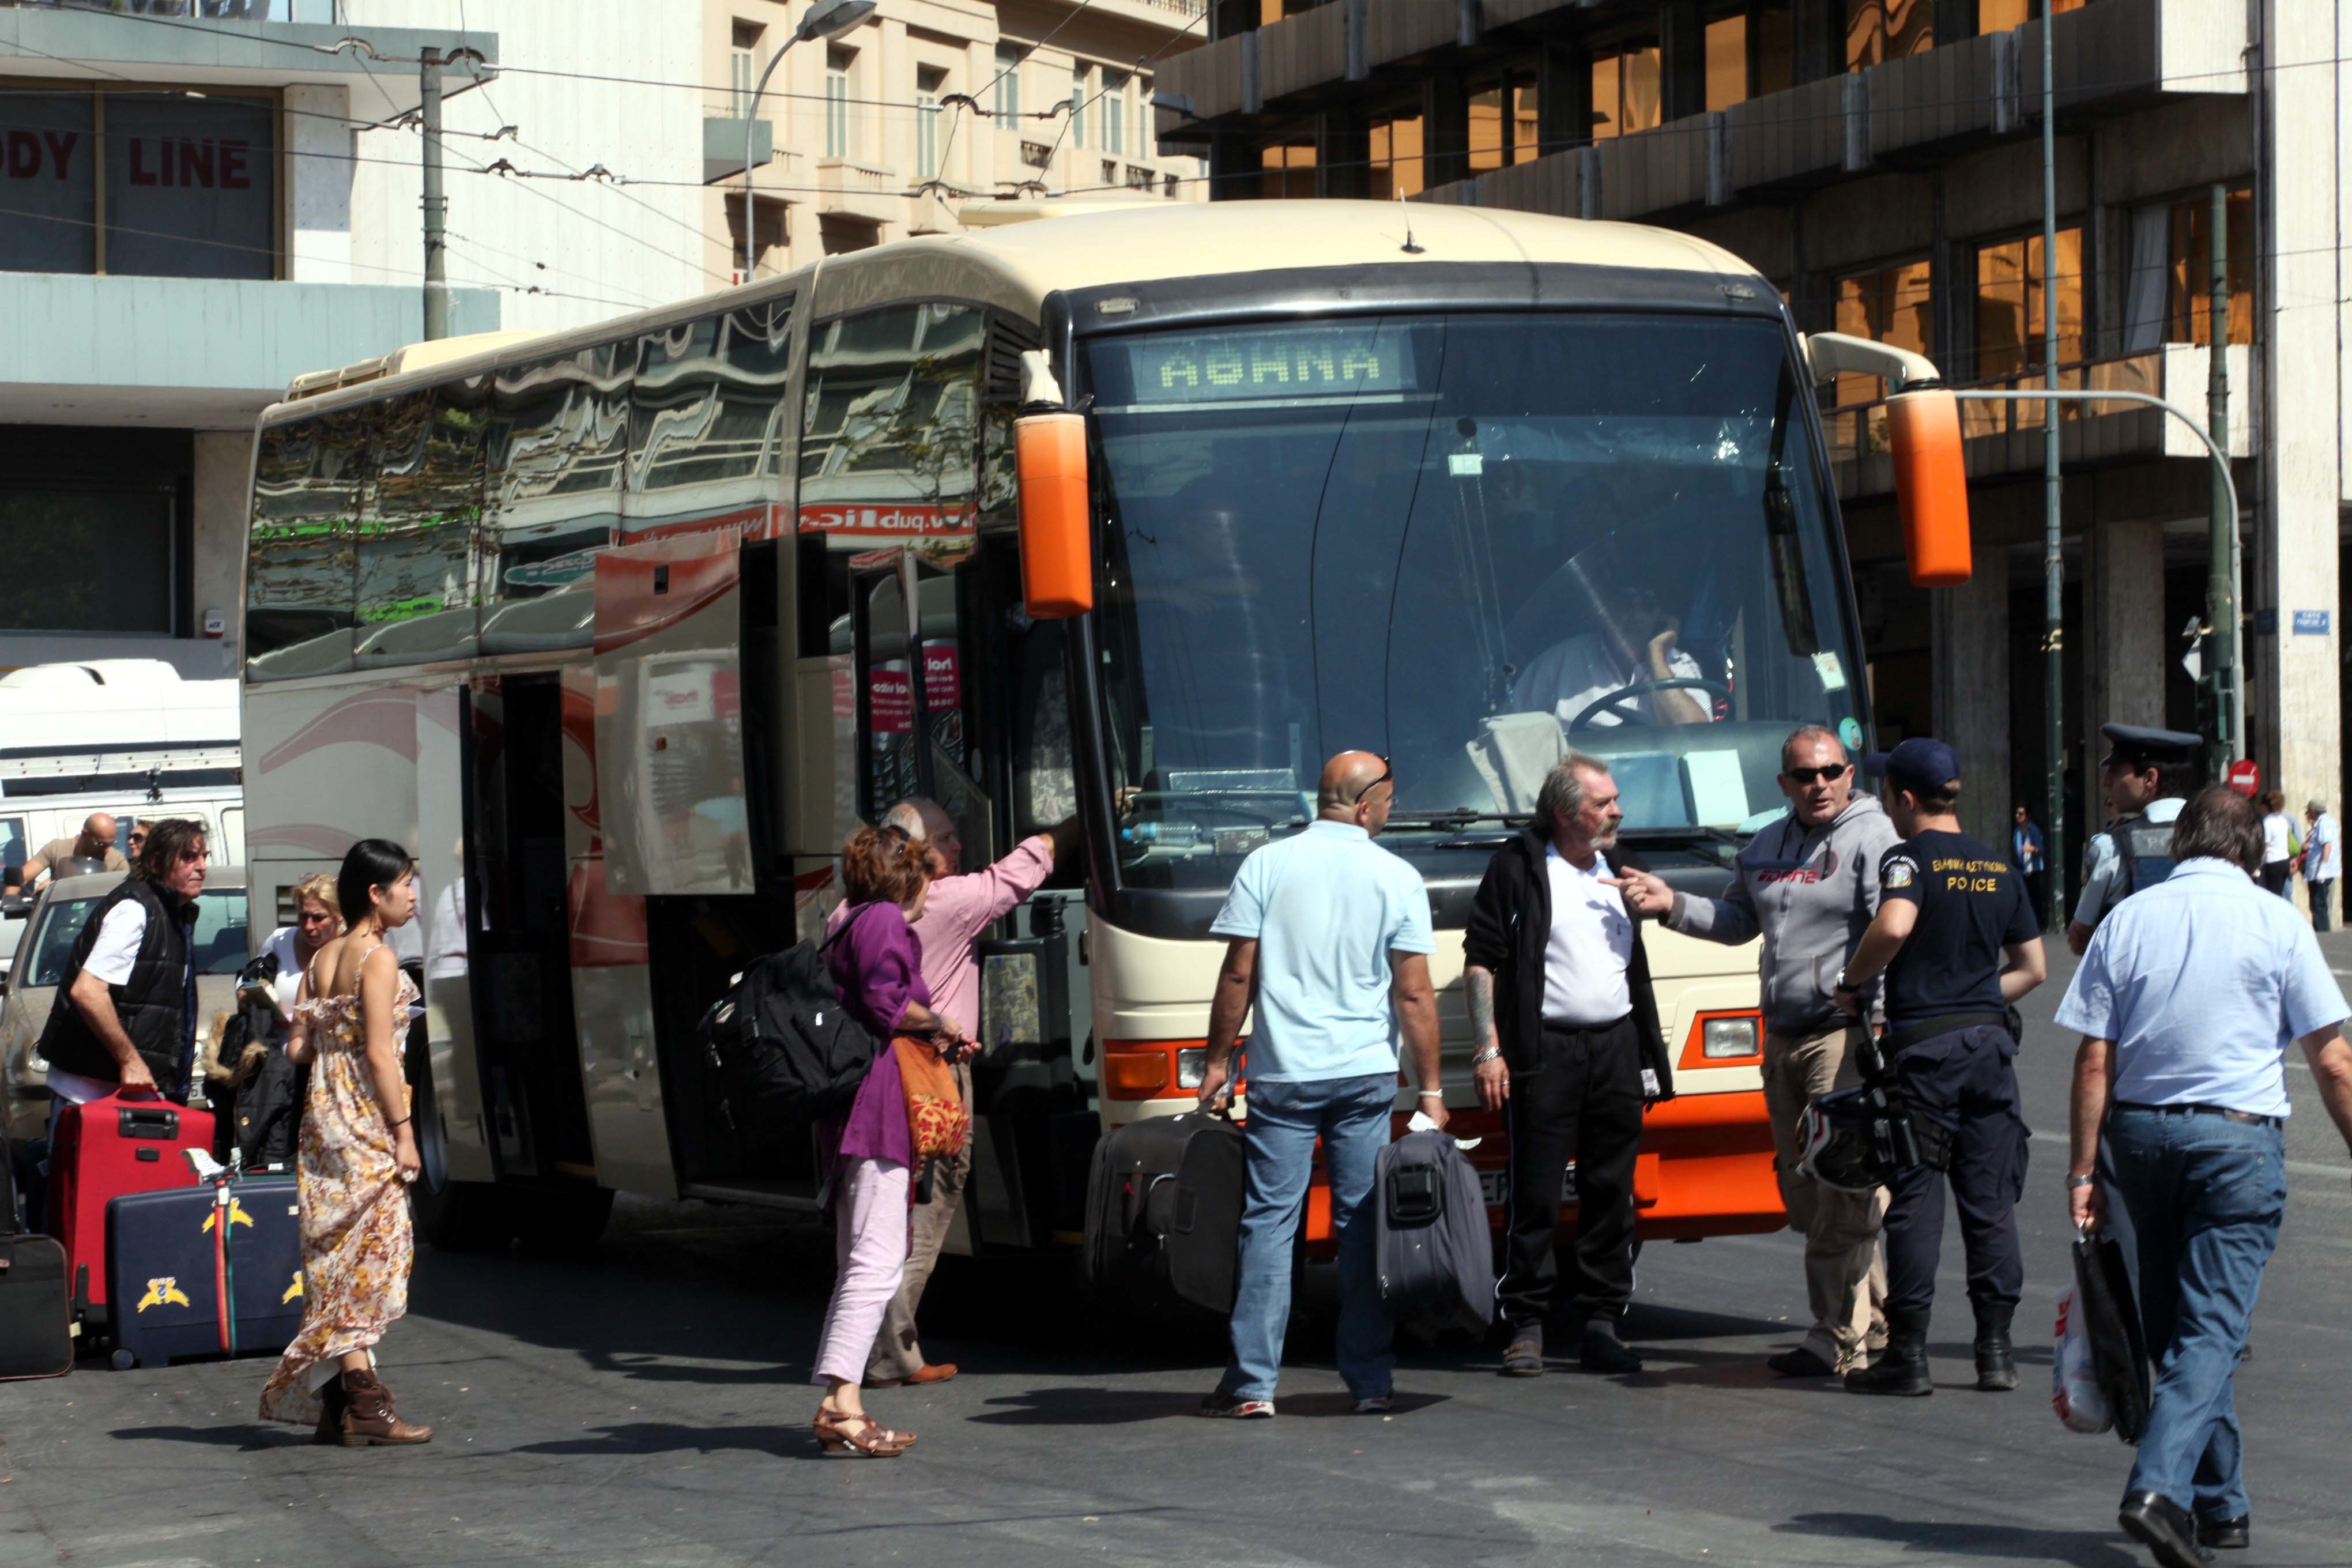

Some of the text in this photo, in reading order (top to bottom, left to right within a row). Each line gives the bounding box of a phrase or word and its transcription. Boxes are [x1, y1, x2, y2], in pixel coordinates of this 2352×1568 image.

[0, 130, 251, 190] DY LINE
[1160, 344, 1379, 387] ΑΘΗΝΑ
[1947, 876, 1996, 892] POICE
